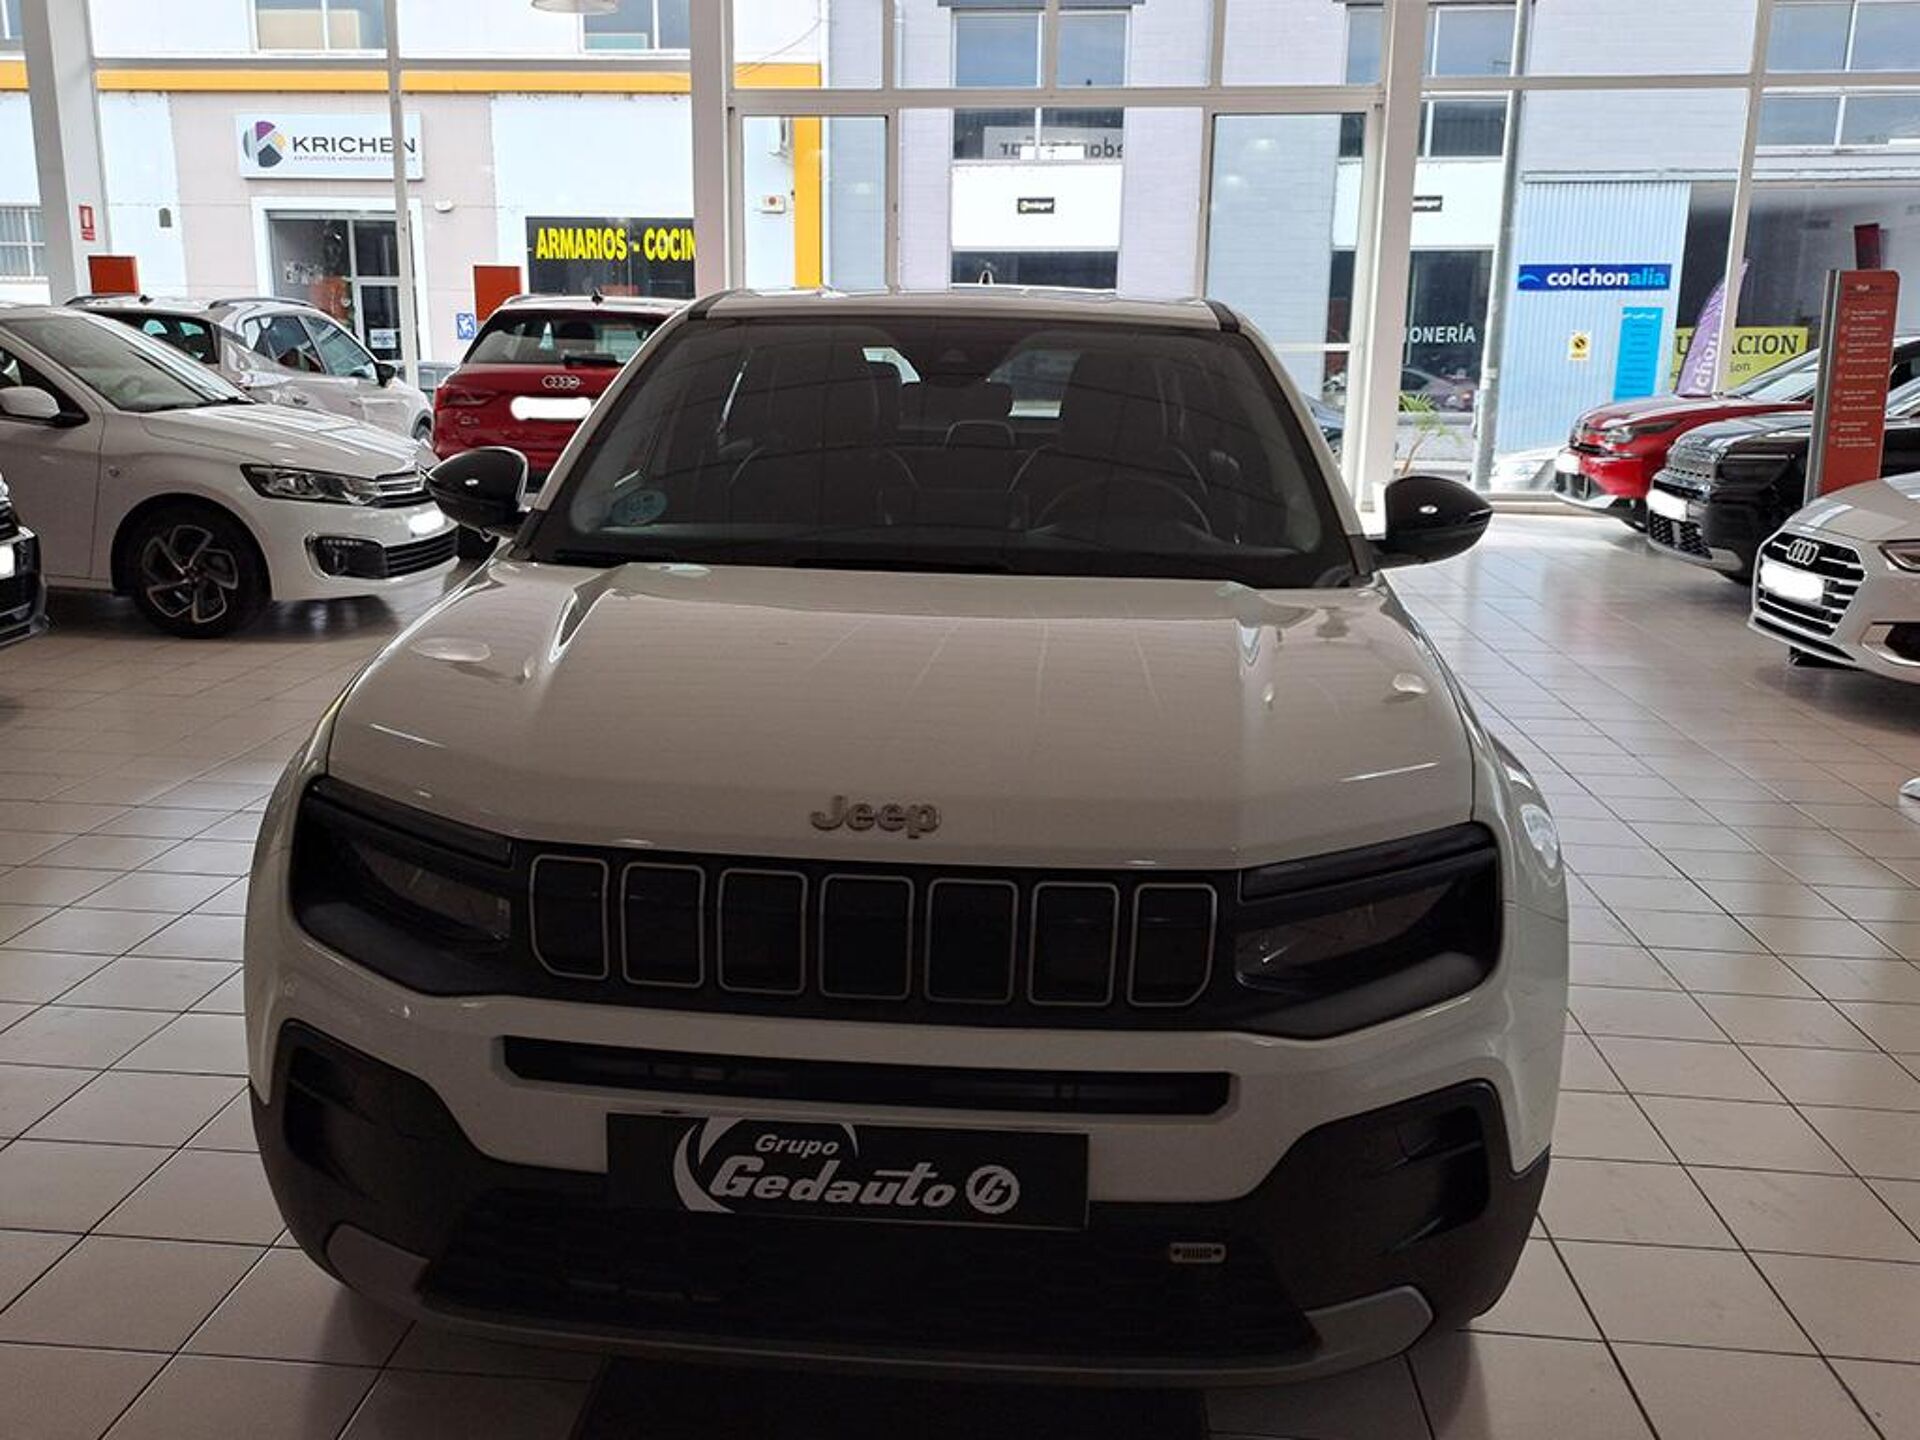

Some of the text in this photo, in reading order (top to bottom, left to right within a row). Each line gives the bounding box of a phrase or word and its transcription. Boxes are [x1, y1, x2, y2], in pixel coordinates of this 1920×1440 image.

[293, 136, 416, 153] KRICHEN
[536, 227, 628, 261] ARMARIOS
[1547, 268, 1666, 286] colchonalia
[810, 795, 941, 839] Jeep
[755, 1133, 839, 1158] Grupo
[709, 1155, 956, 1207] Gedauto
